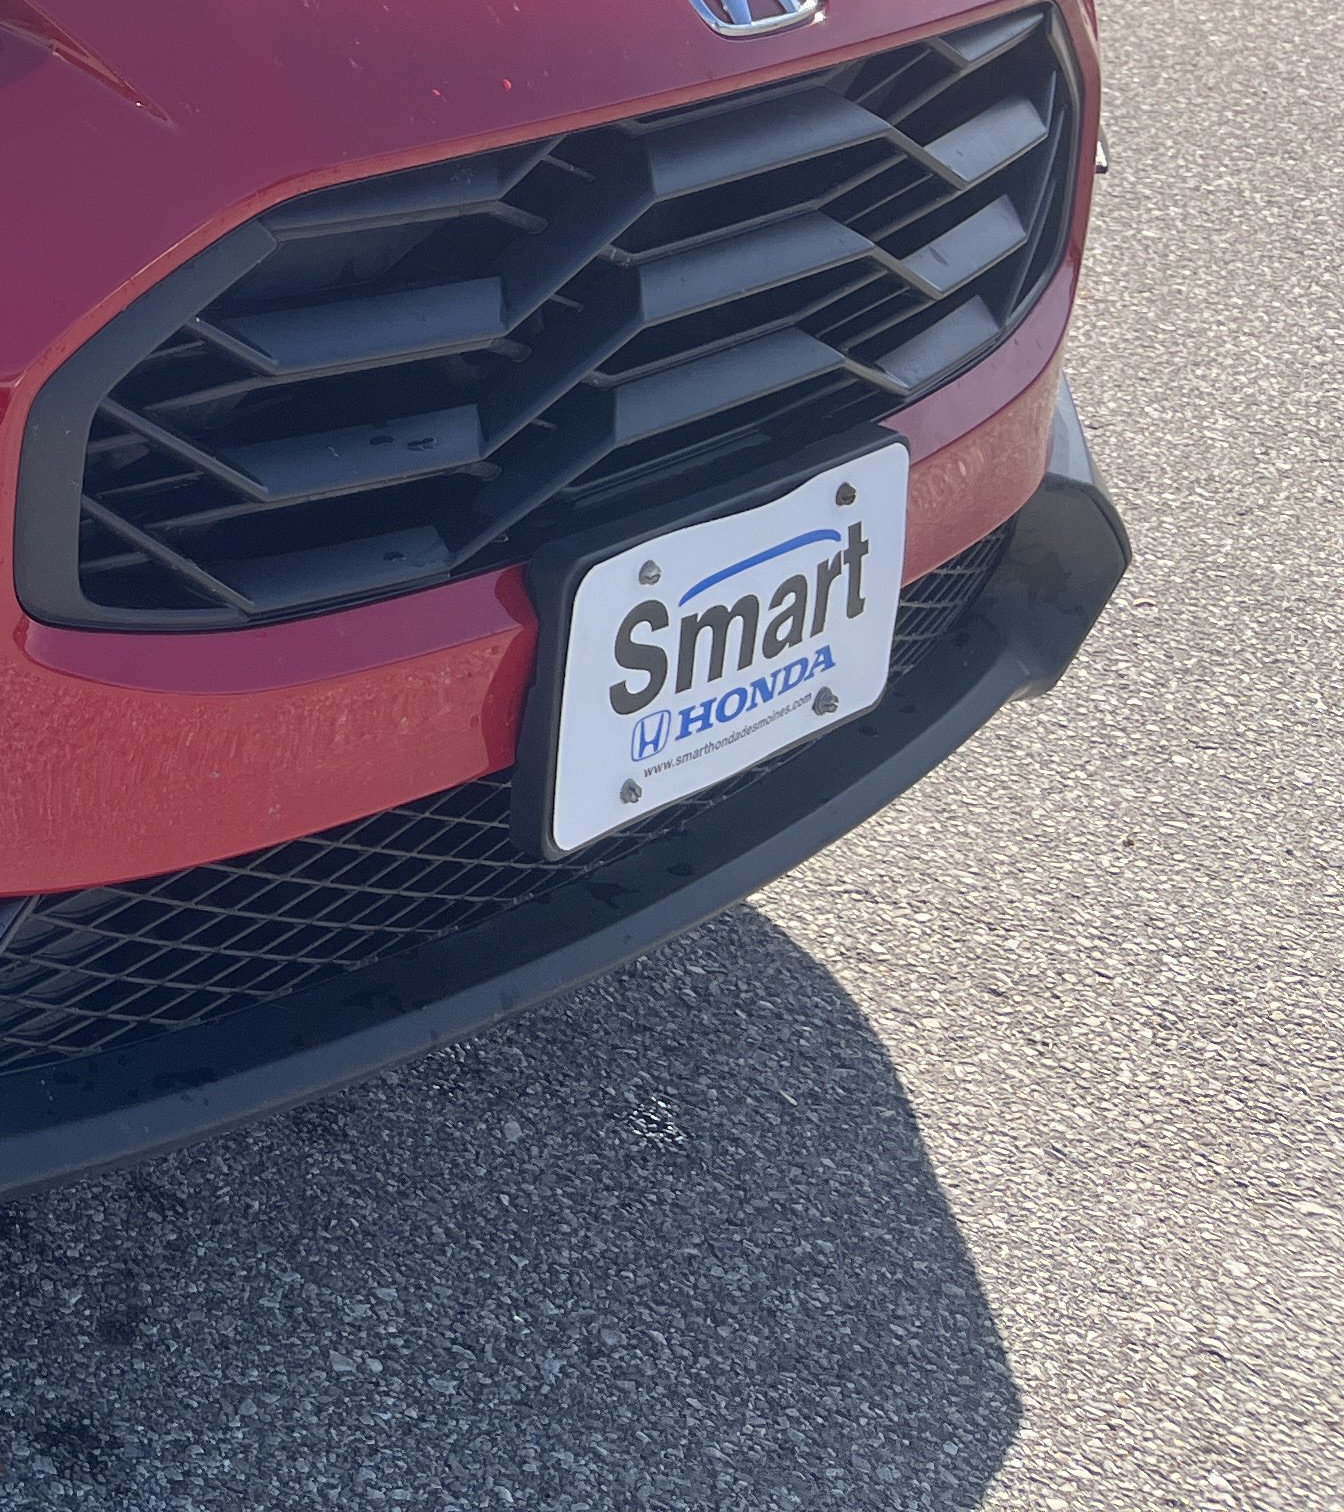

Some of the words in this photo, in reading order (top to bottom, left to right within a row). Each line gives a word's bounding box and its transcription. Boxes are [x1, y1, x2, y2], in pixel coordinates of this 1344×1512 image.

[608, 520, 870, 716] Smart
[643, 692, 813, 779] www.smarthondadesmoines.com
[674, 643, 837, 742] HONDA
